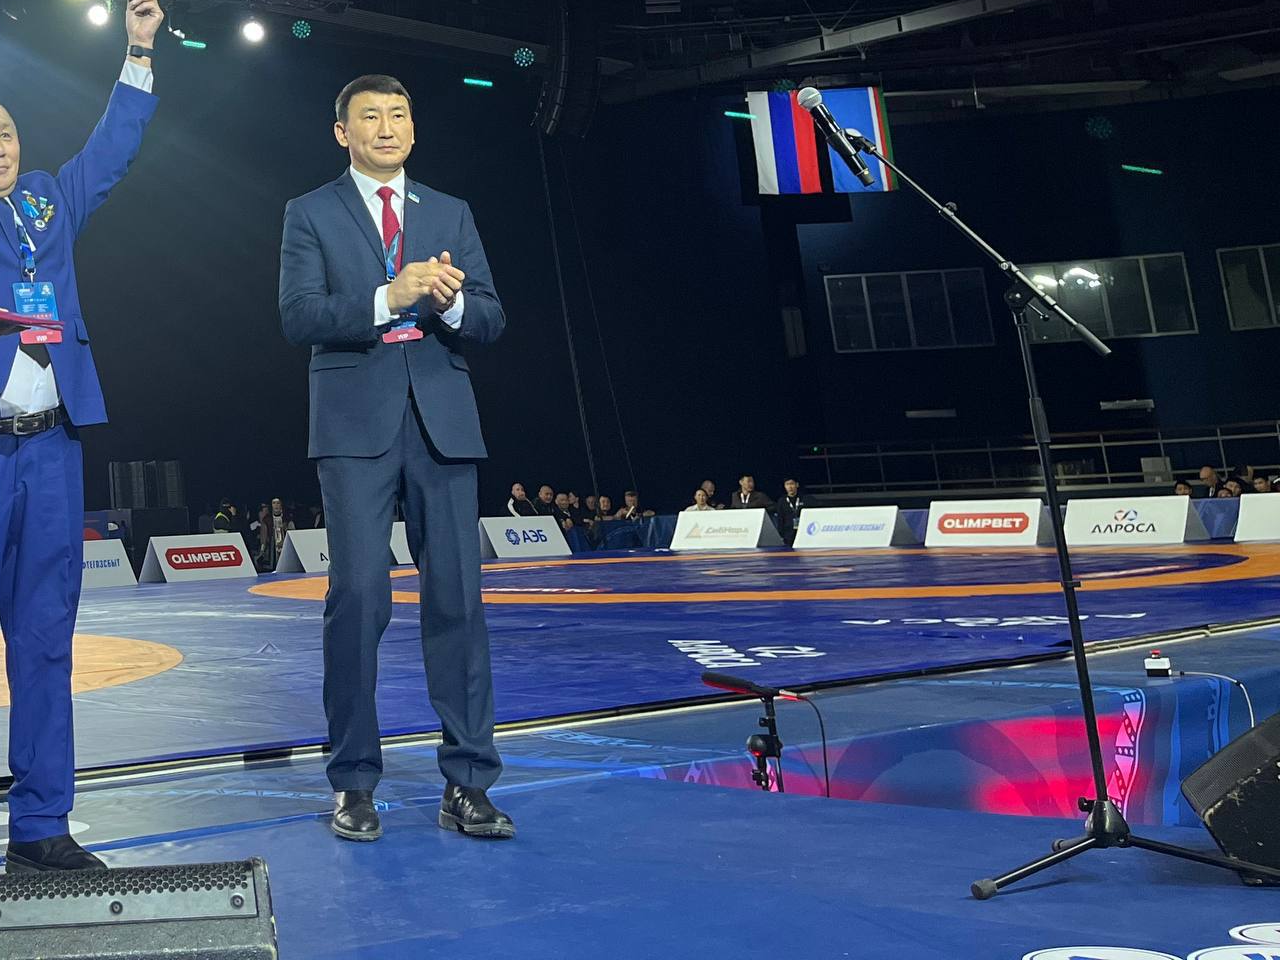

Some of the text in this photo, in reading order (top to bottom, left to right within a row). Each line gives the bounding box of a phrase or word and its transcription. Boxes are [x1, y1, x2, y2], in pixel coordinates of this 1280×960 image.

[943, 517, 1023, 530] OLIMPBET
[523, 529, 548, 544] АЭБ
[171, 550, 236, 565] OLIMPBET
